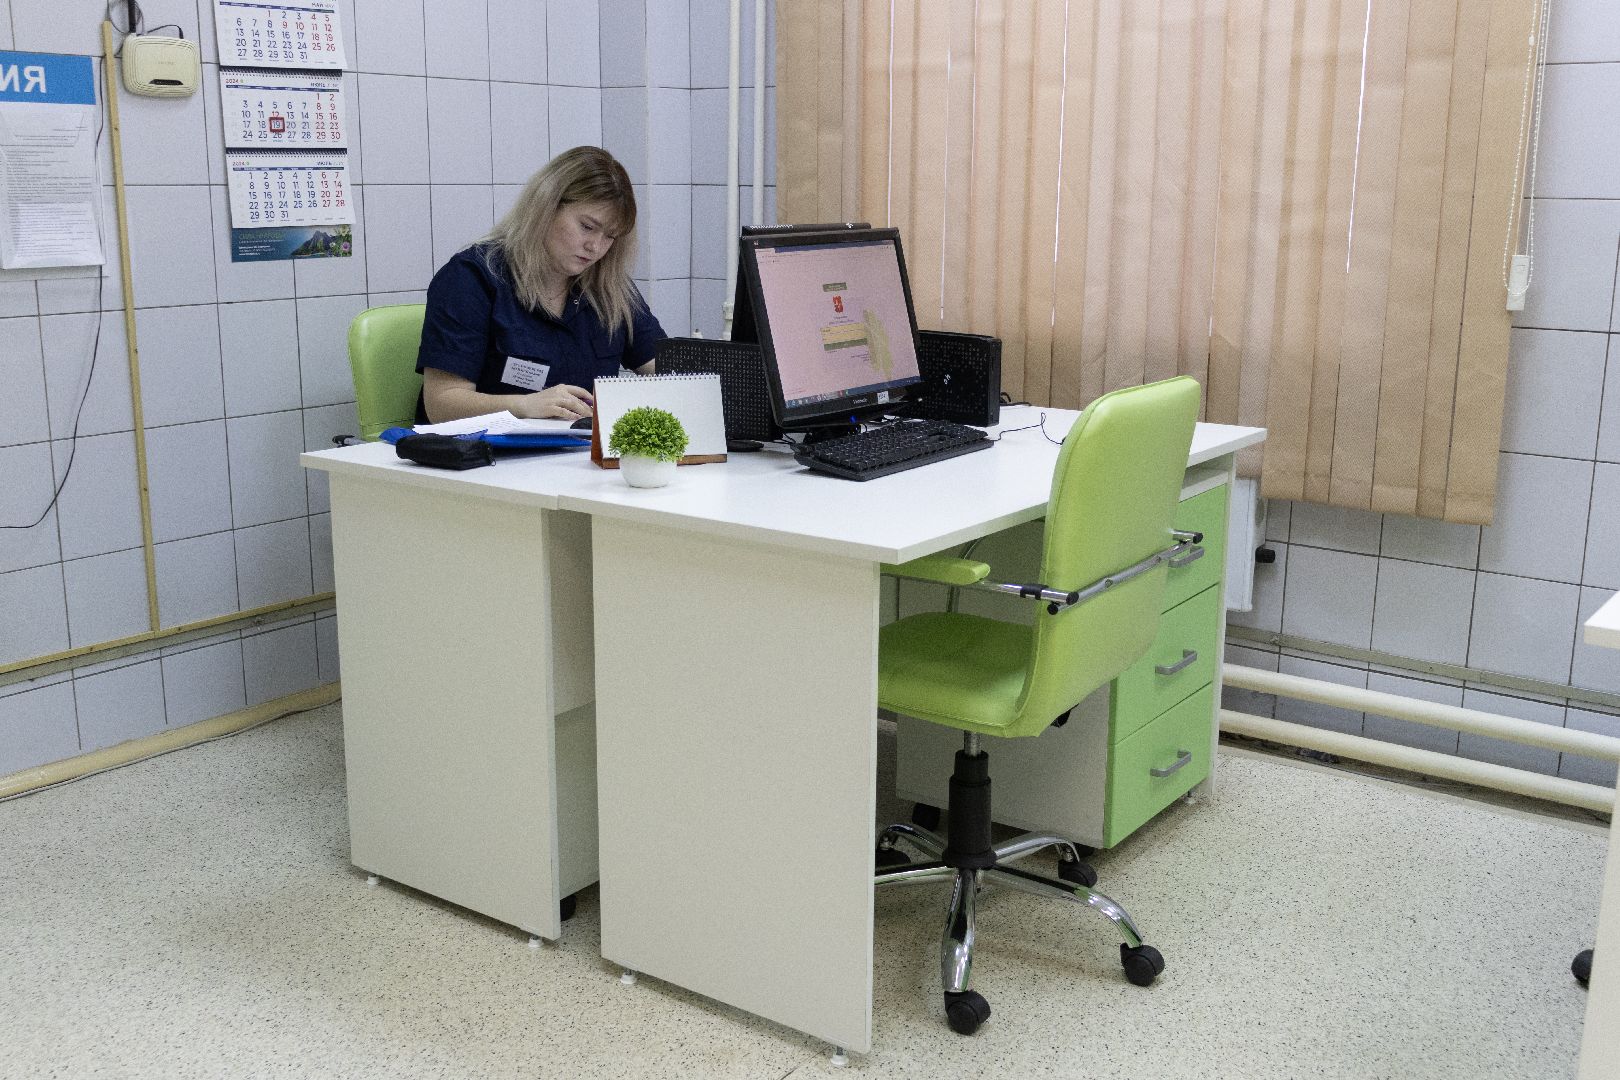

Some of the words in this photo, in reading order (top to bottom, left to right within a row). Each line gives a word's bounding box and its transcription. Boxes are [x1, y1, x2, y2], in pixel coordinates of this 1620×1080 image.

[296, 22, 304, 30] 10
[283, 41, 292, 49] 23
[298, 42, 307, 50] 24
[312, 43, 321, 51] 25
[238, 49, 247, 57] 27
[253, 50, 263, 58] 28
[284, 51, 293, 59] 30
[316, 122, 325, 130] 22
[330, 122, 339, 130] 23
[258, 131, 267, 139] 25
[307, 181, 314, 189] 12
[321, 181, 328, 189] 13
